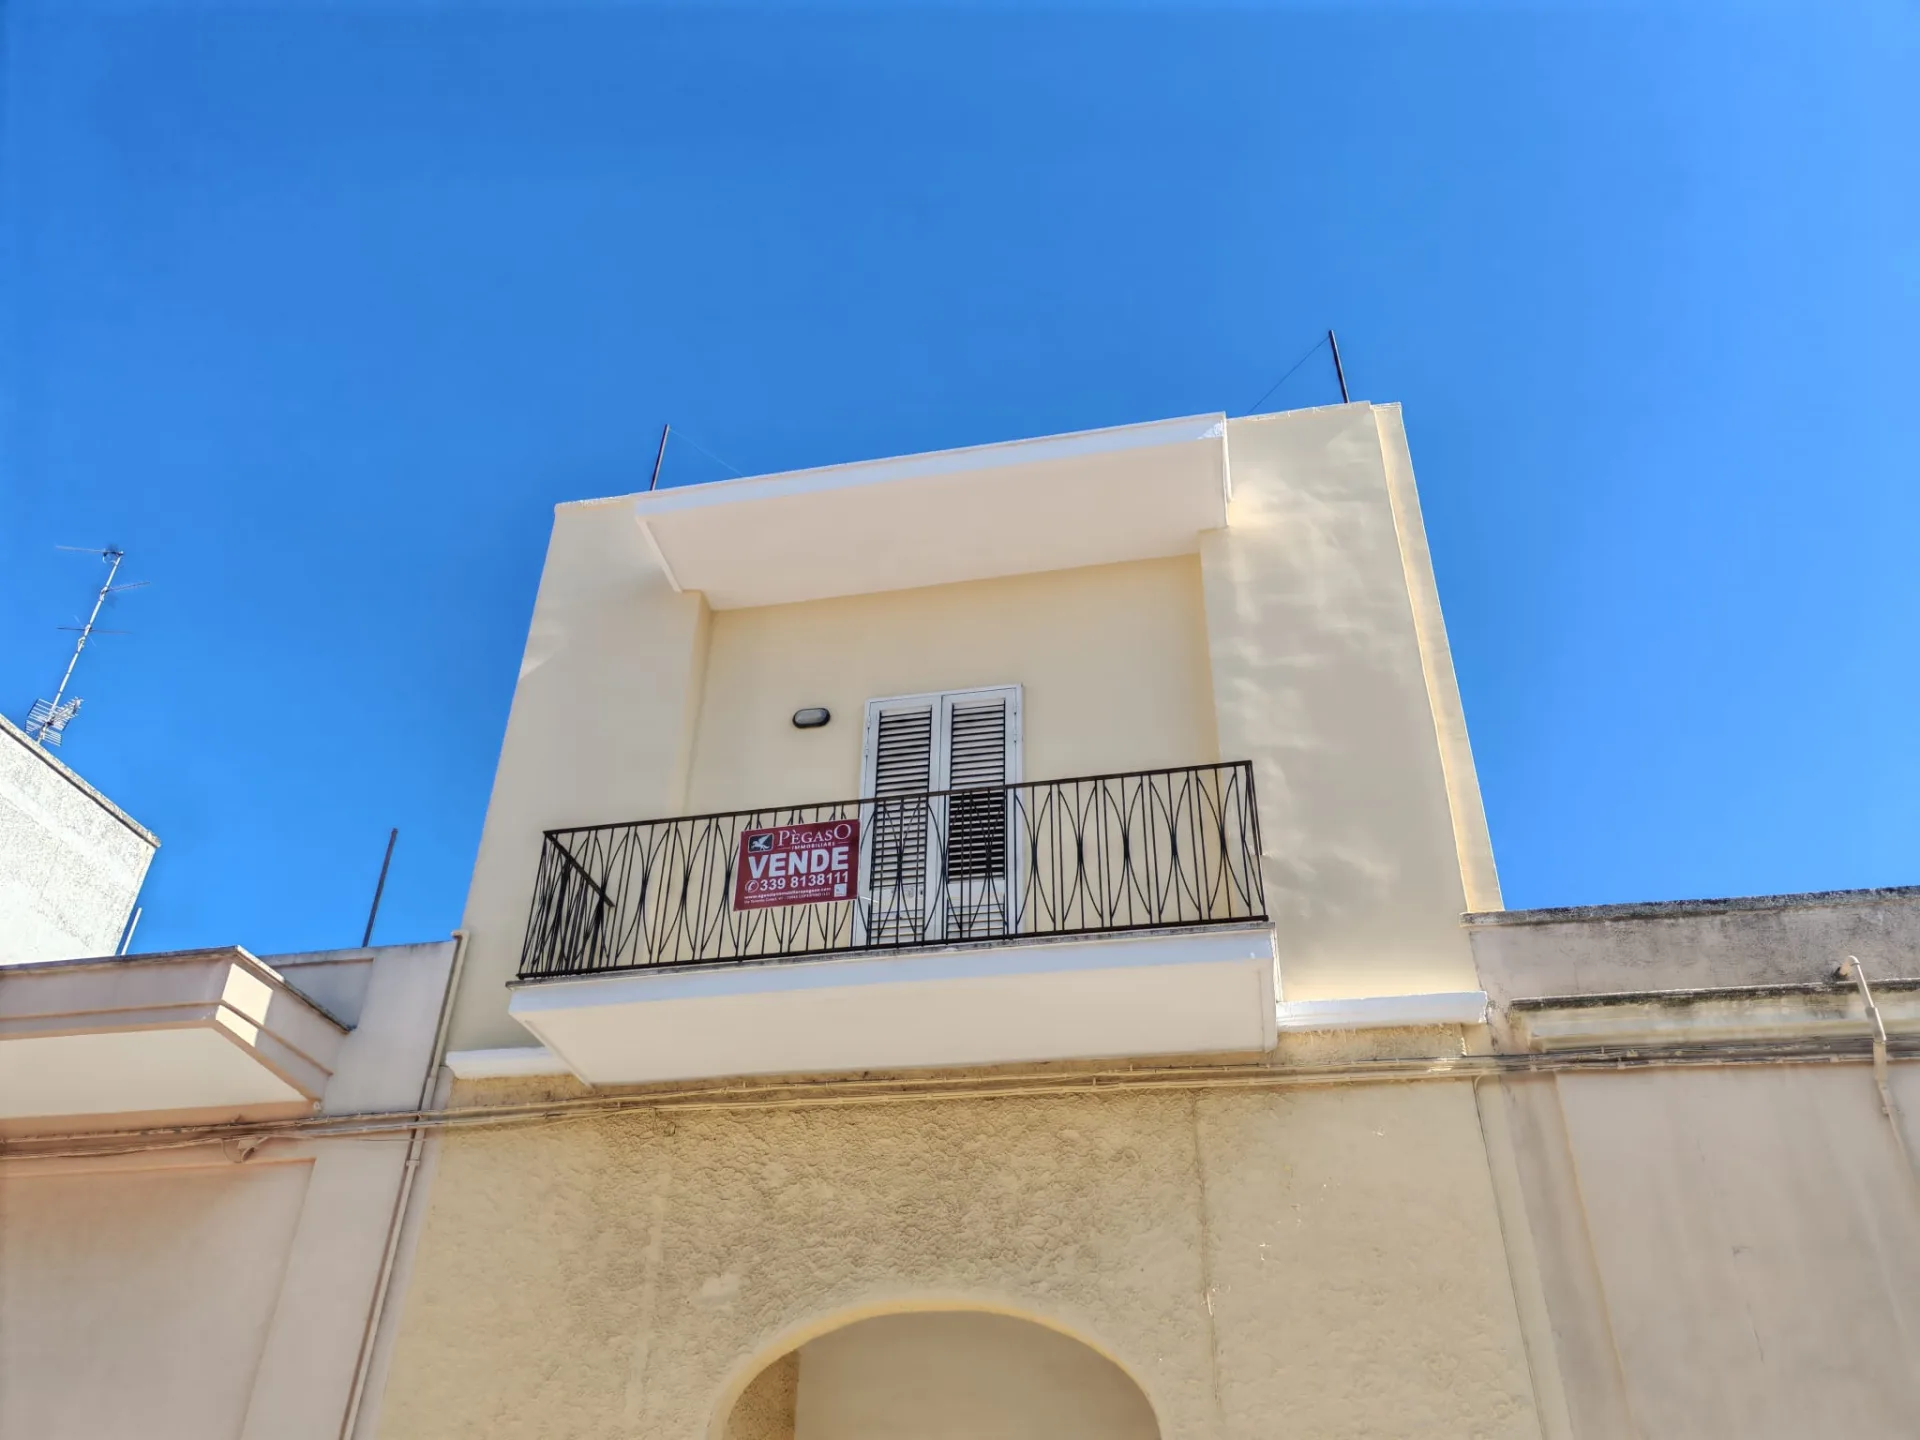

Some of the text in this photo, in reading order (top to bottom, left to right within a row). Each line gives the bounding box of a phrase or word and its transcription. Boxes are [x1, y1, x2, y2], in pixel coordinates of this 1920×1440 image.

[748, 846, 849, 879] VENDE
[760, 871, 848, 891] 339 8138111
